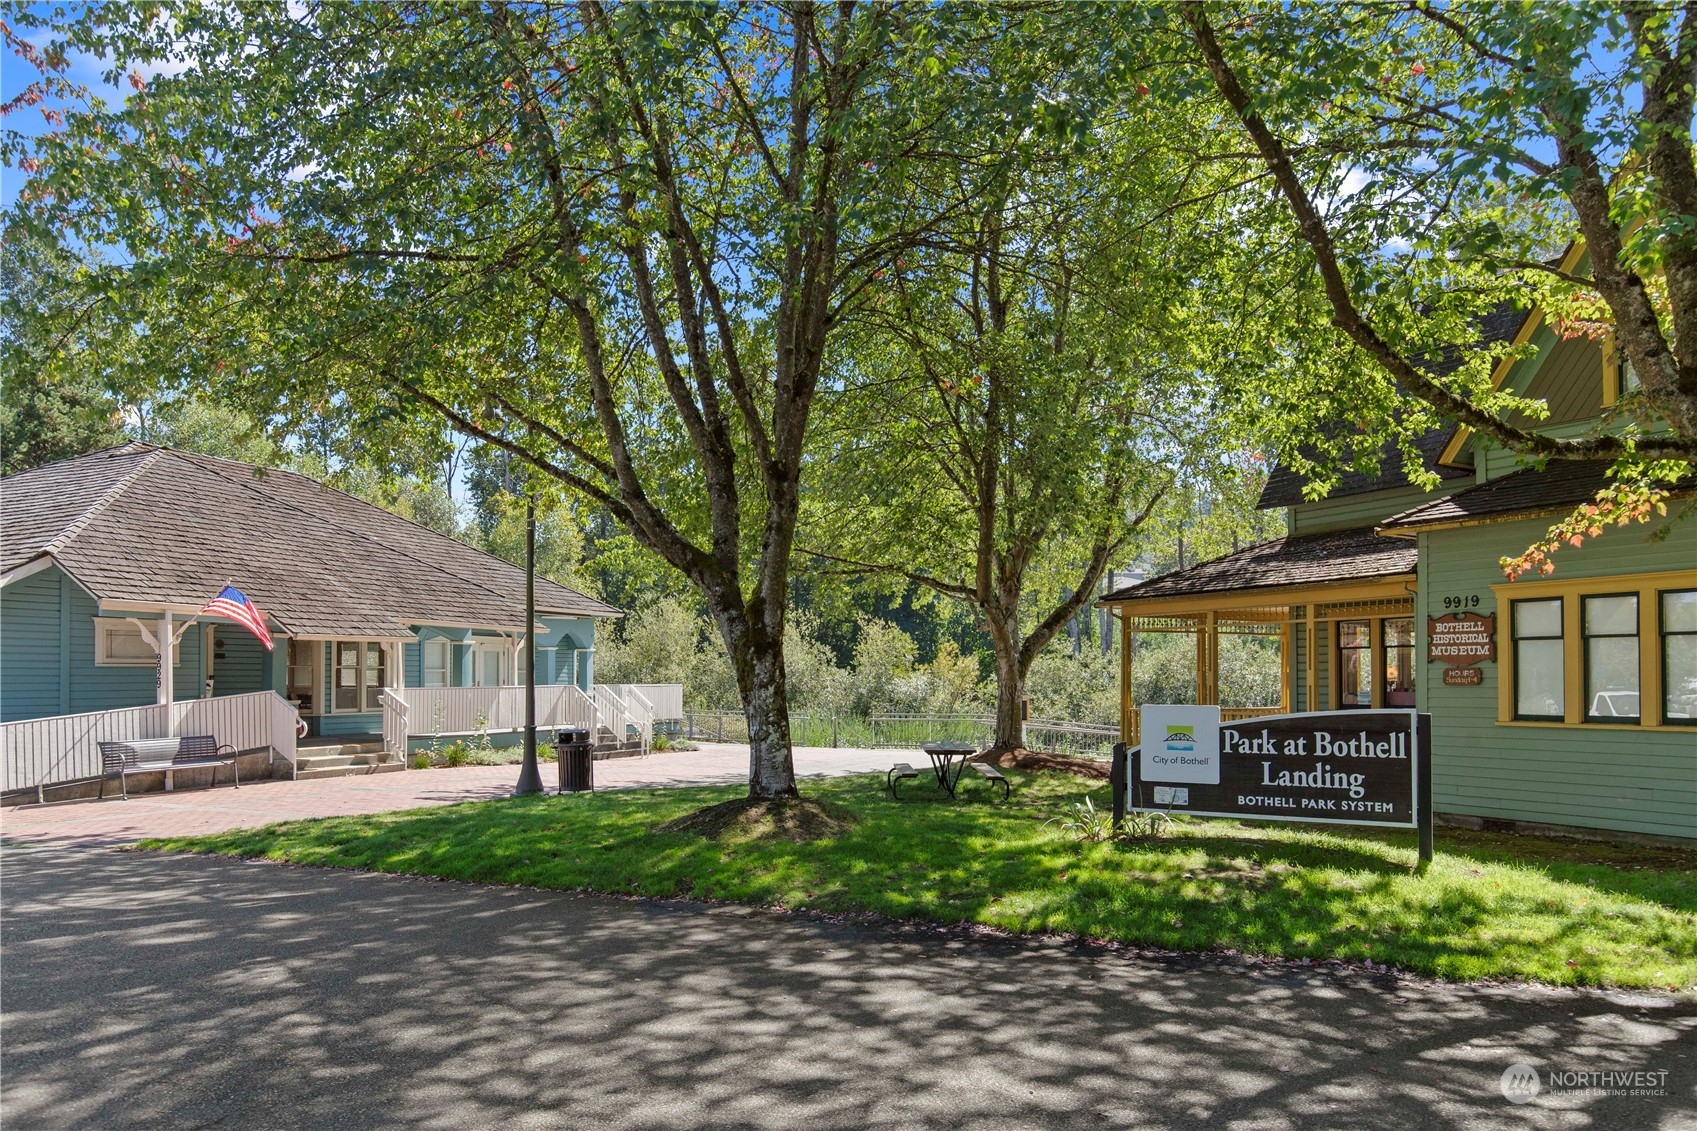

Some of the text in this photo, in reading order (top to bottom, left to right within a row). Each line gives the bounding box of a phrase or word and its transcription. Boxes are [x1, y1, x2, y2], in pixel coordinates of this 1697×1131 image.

[1443, 595, 1480, 609] 9919
[1435, 622, 1484, 632] BOTHELL
[1432, 633, 1489, 644] HISTORICAL
[1431, 645, 1490, 656] MUSEUM
[1223, 728, 1407, 759] Park at Bothell
[1152, 755, 1209, 766] City of Bothell
[1261, 761, 1366, 799] Landing
[1237, 795, 1394, 813] BOTHELL PARK SYSTEM
